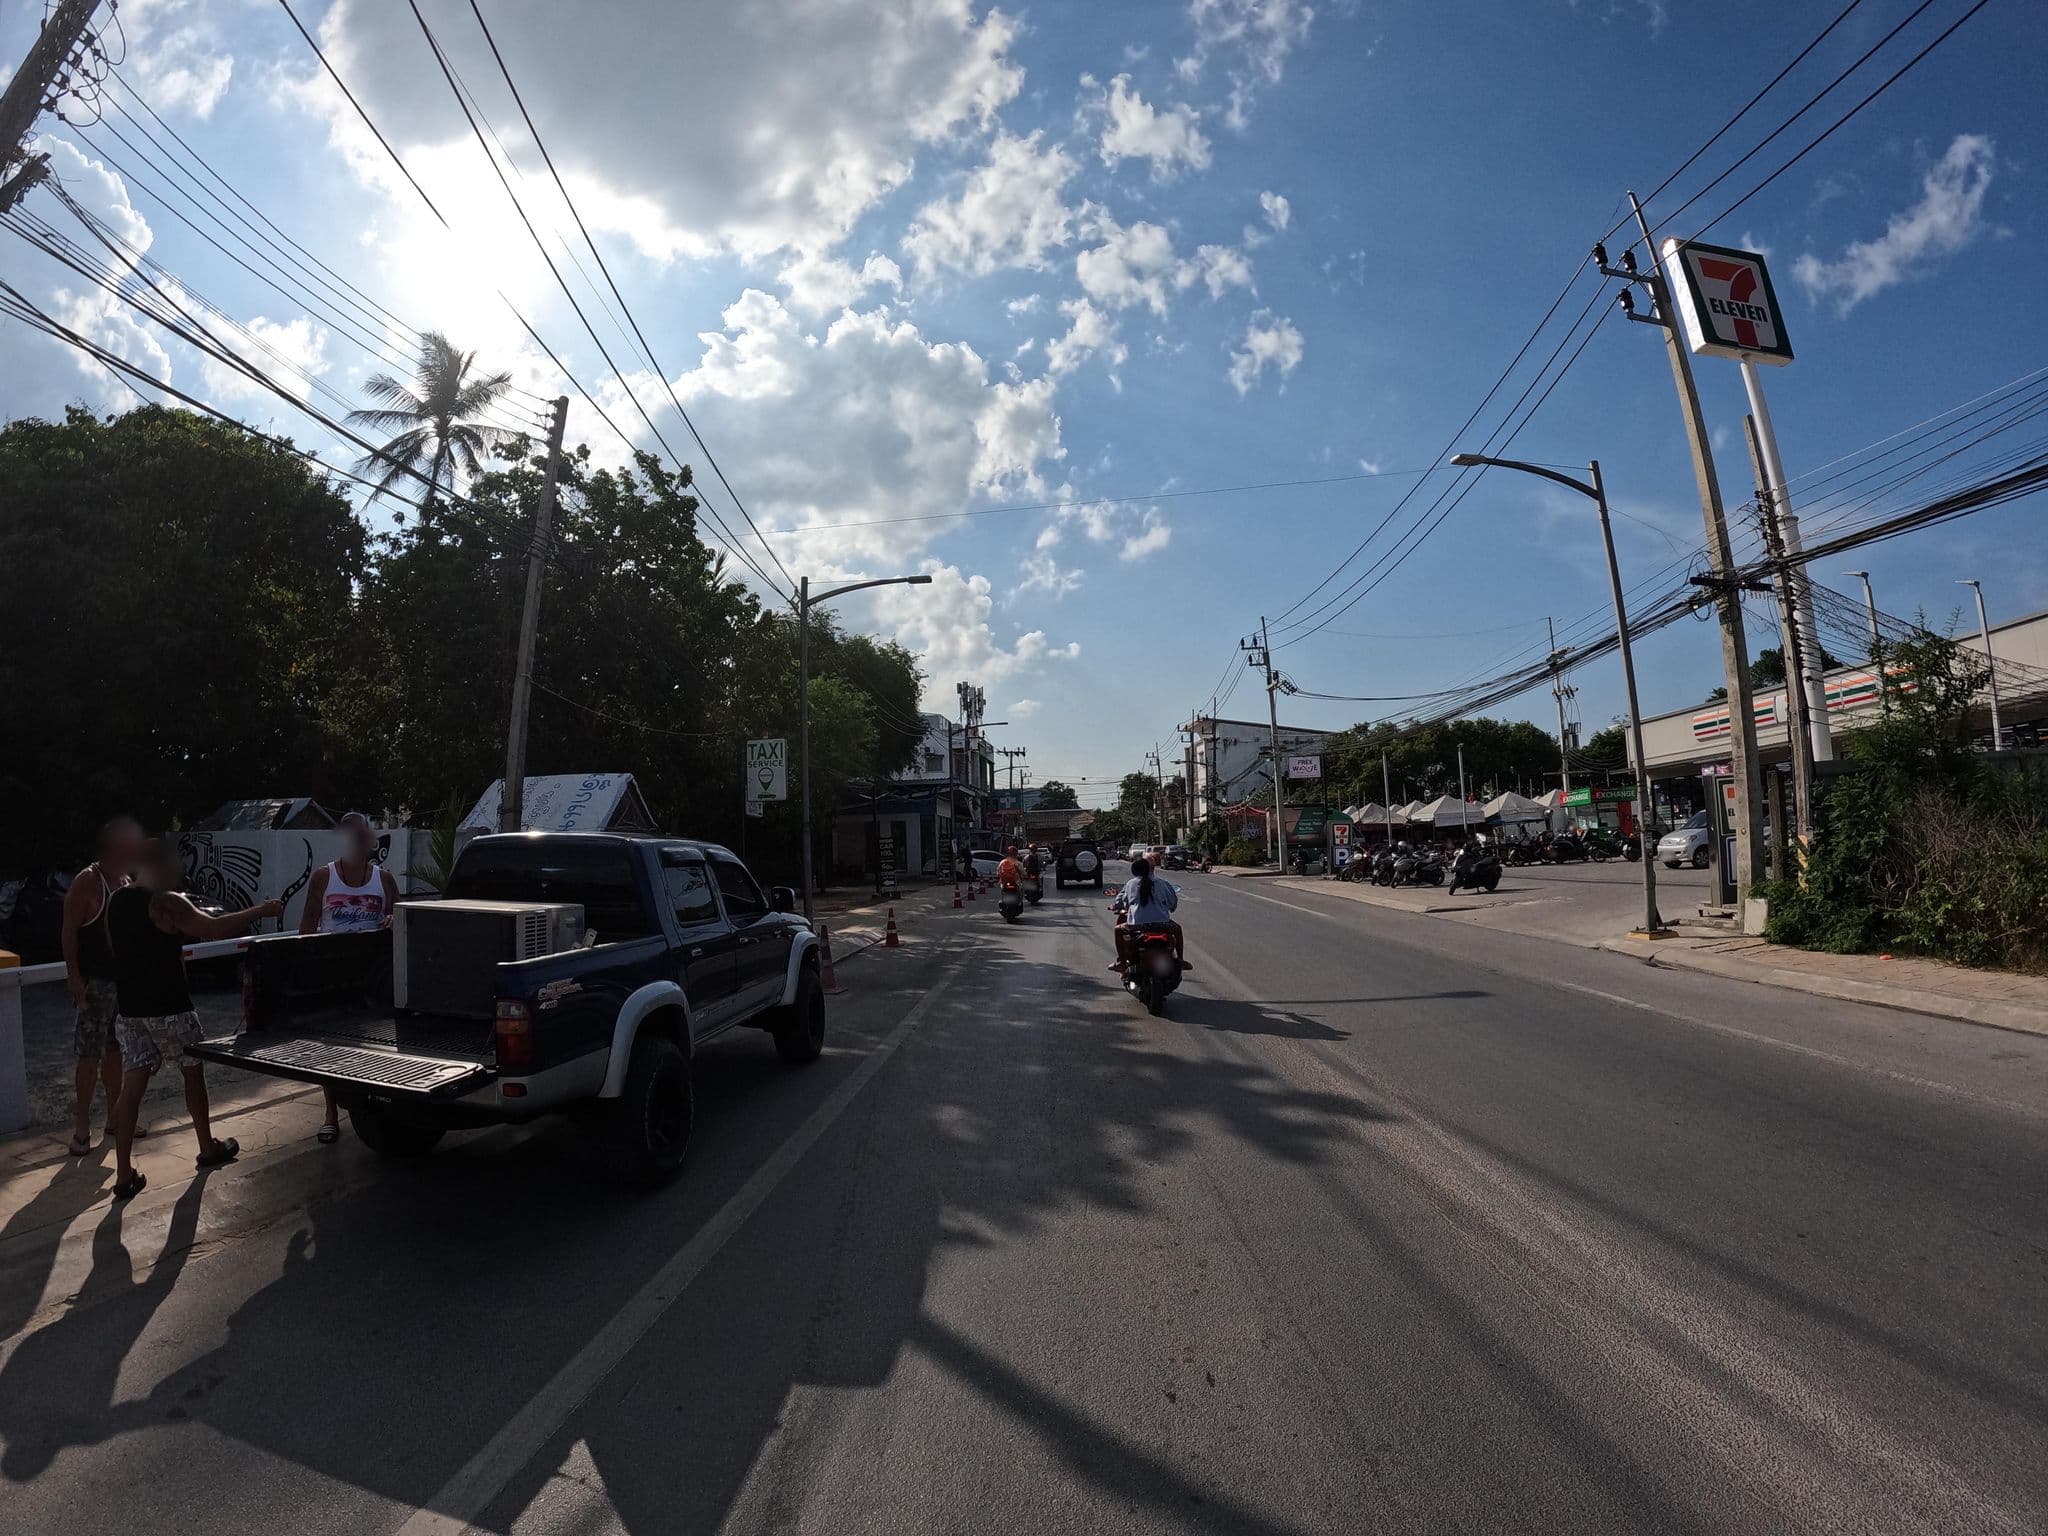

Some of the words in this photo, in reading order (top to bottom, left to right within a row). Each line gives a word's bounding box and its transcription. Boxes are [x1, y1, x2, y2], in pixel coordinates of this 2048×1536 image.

[1698, 257, 1760, 349] 7
[748, 742, 784, 760] TAXI
[747, 759, 784, 768] SERVICE
[1596, 790, 1637, 799] EXCHANGE
[1335, 848, 1349, 865] P
